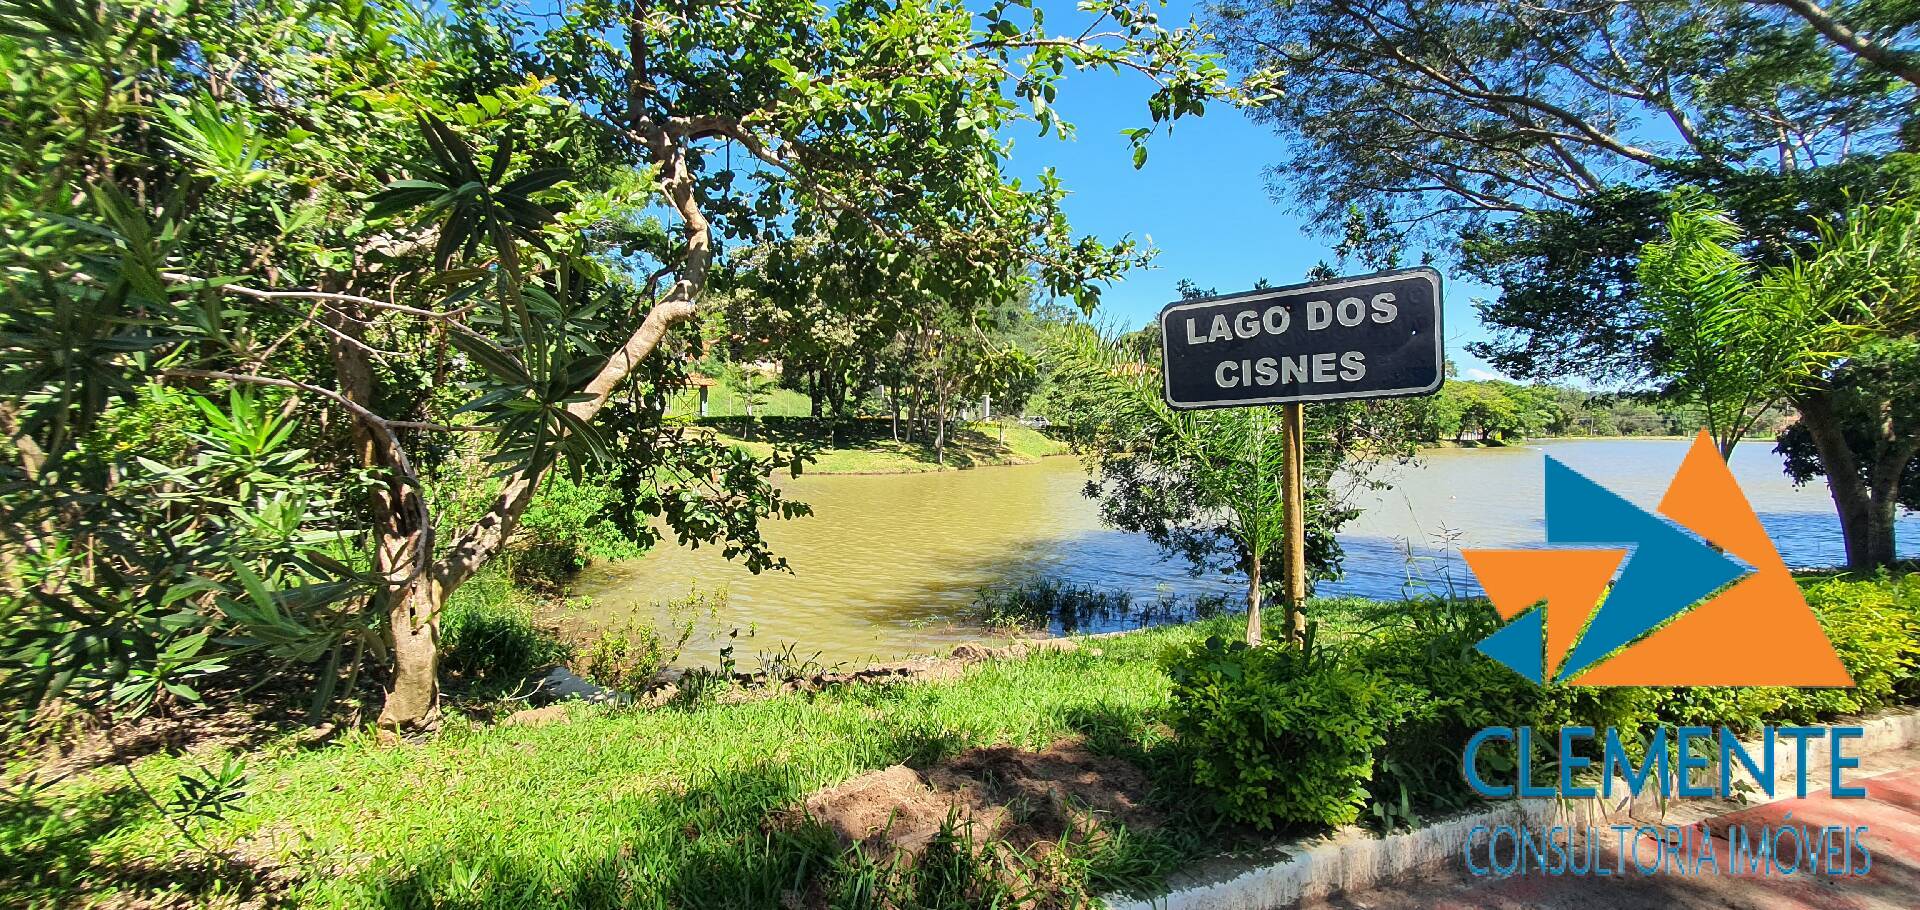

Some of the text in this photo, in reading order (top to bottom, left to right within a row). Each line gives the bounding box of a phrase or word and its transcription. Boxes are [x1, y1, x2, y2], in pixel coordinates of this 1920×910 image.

[1186, 292, 1398, 345] LAGO DOS
[1215, 351, 1367, 388] CISNES
